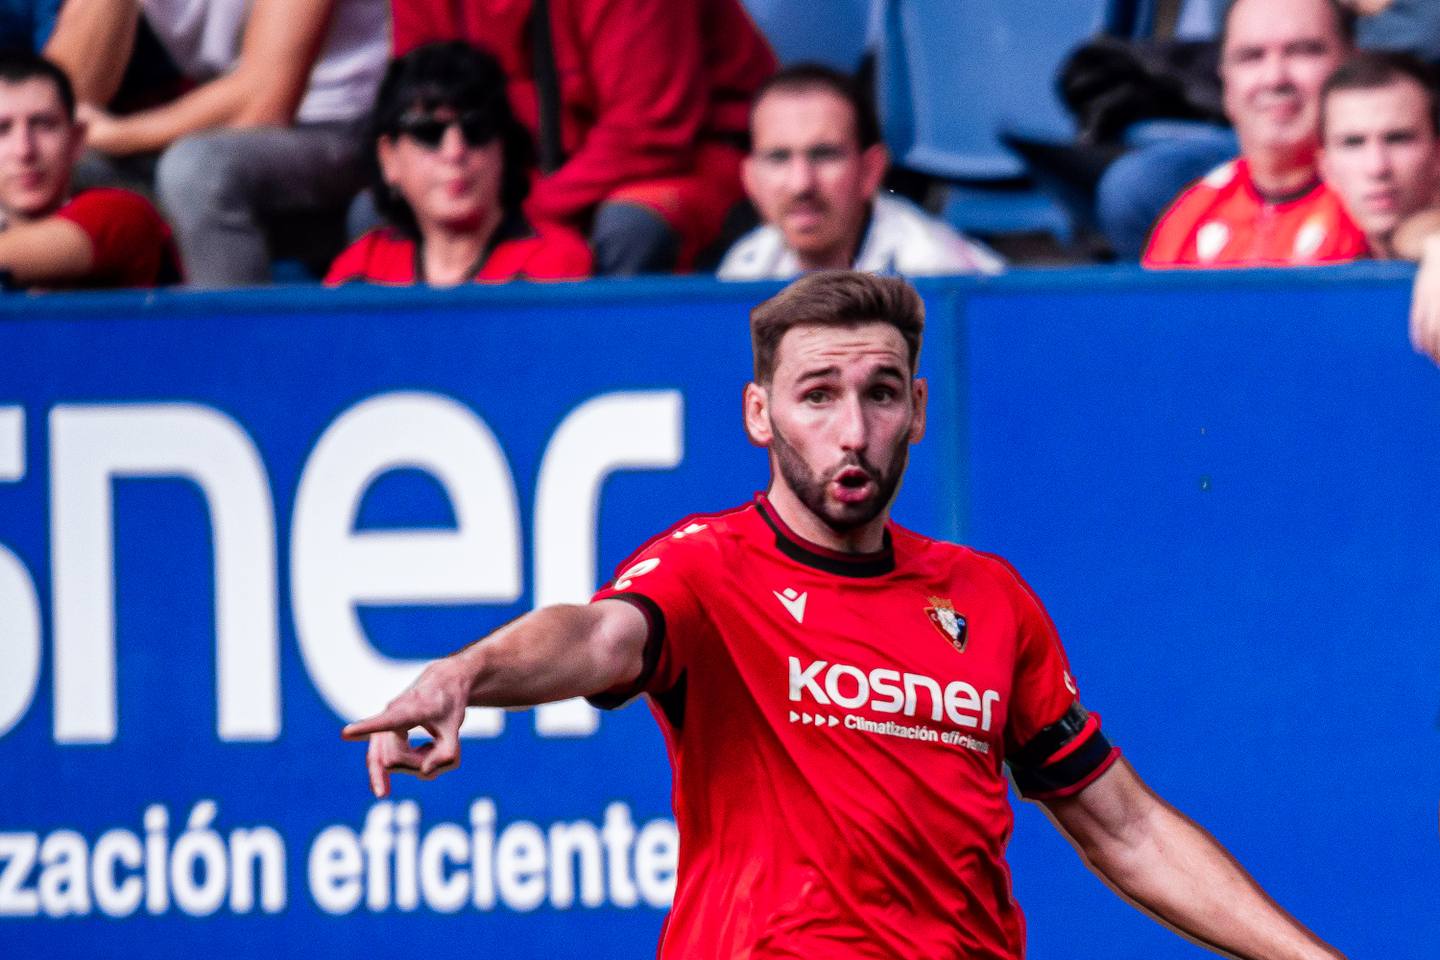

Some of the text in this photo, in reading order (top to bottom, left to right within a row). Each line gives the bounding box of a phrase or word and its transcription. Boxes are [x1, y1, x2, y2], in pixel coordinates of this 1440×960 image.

[0, 389, 684, 745] ner
[843, 713, 939, 743] Climatización
[308, 799, 679, 914] eficiente
